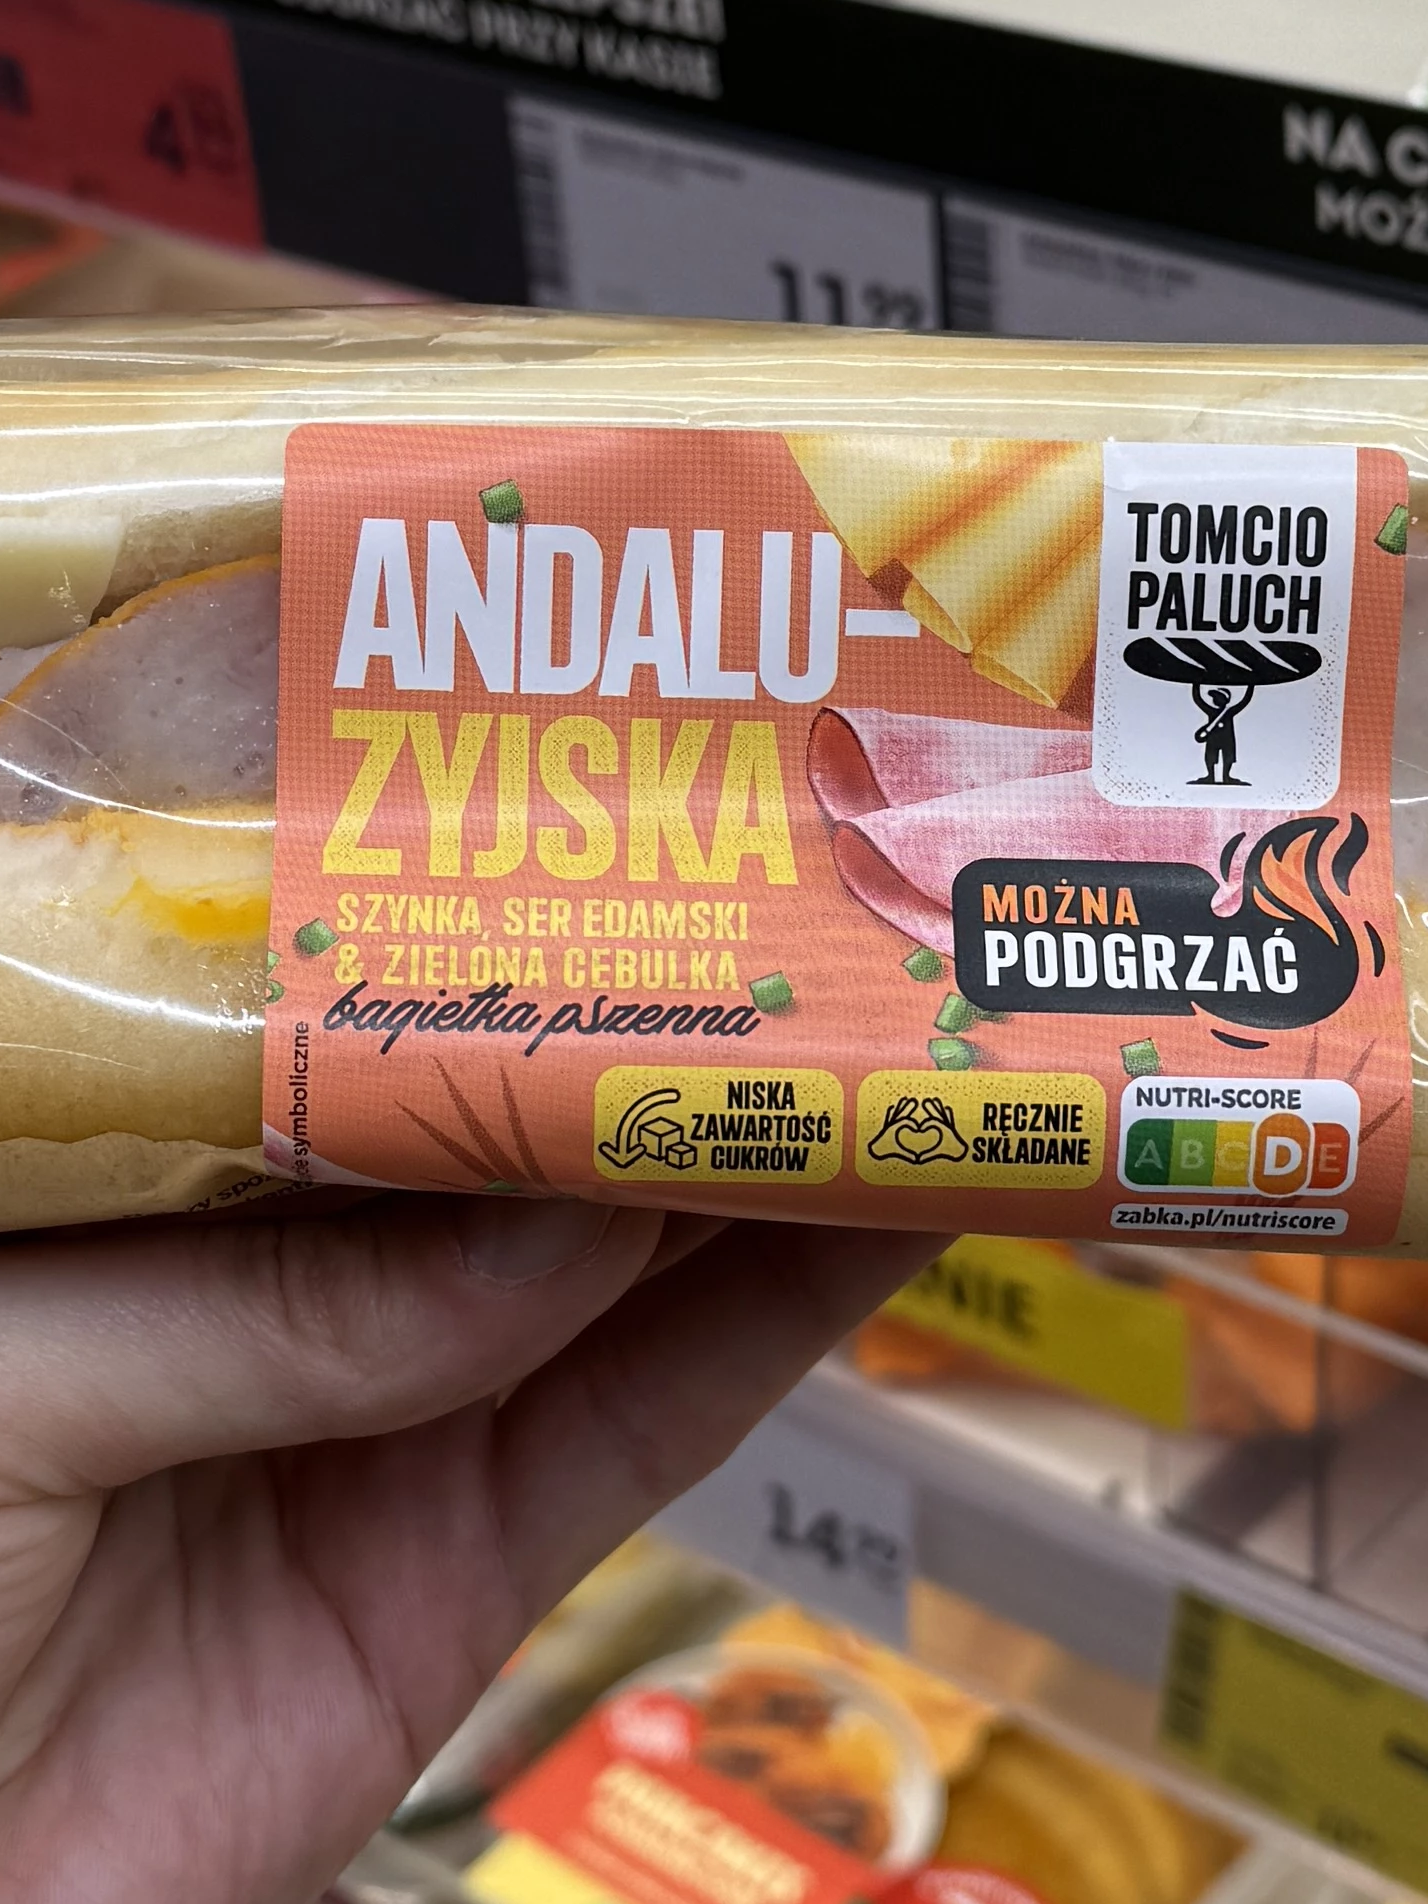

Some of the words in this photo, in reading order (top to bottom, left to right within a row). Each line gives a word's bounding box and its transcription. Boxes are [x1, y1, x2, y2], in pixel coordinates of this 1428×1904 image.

[1283, 103, 1379, 178] NA
[1125, 501, 1330, 569] TOMCIO
[1124, 573, 1323, 637] PALUCH
[321, 707, 799, 887] ZYJSKA
[336, 891, 493, 940] SZYNKA,
[502, 900, 572, 938] SER
[582, 899, 750, 942] EDAMSKI
[981, 882, 1141, 927] MOŻNA
[334, 942, 364, 986] &
[383, 944, 549, 989] ZIELONA
[563, 947, 741, 992] CEBULKA
[984, 925, 1300, 996] PODGRZAĆ
[323, 979, 542, 1056] bagietka
[288, 1020, 312, 1158] symboliczne
[726, 1079, 797, 1111] NISKA
[1135, 1086, 1302, 1110] NUTRI-SCORE
[690, 1106, 833, 1146] ZAWARTOŚĆ
[982, 1101, 1084, 1138] RĘCZNIE
[709, 1140, 811, 1175] CUKRÓW
[971, 1133, 1091, 1168] SKŁADANE
[1115, 1206, 1337, 1231] zabka.pl/nutriscore
